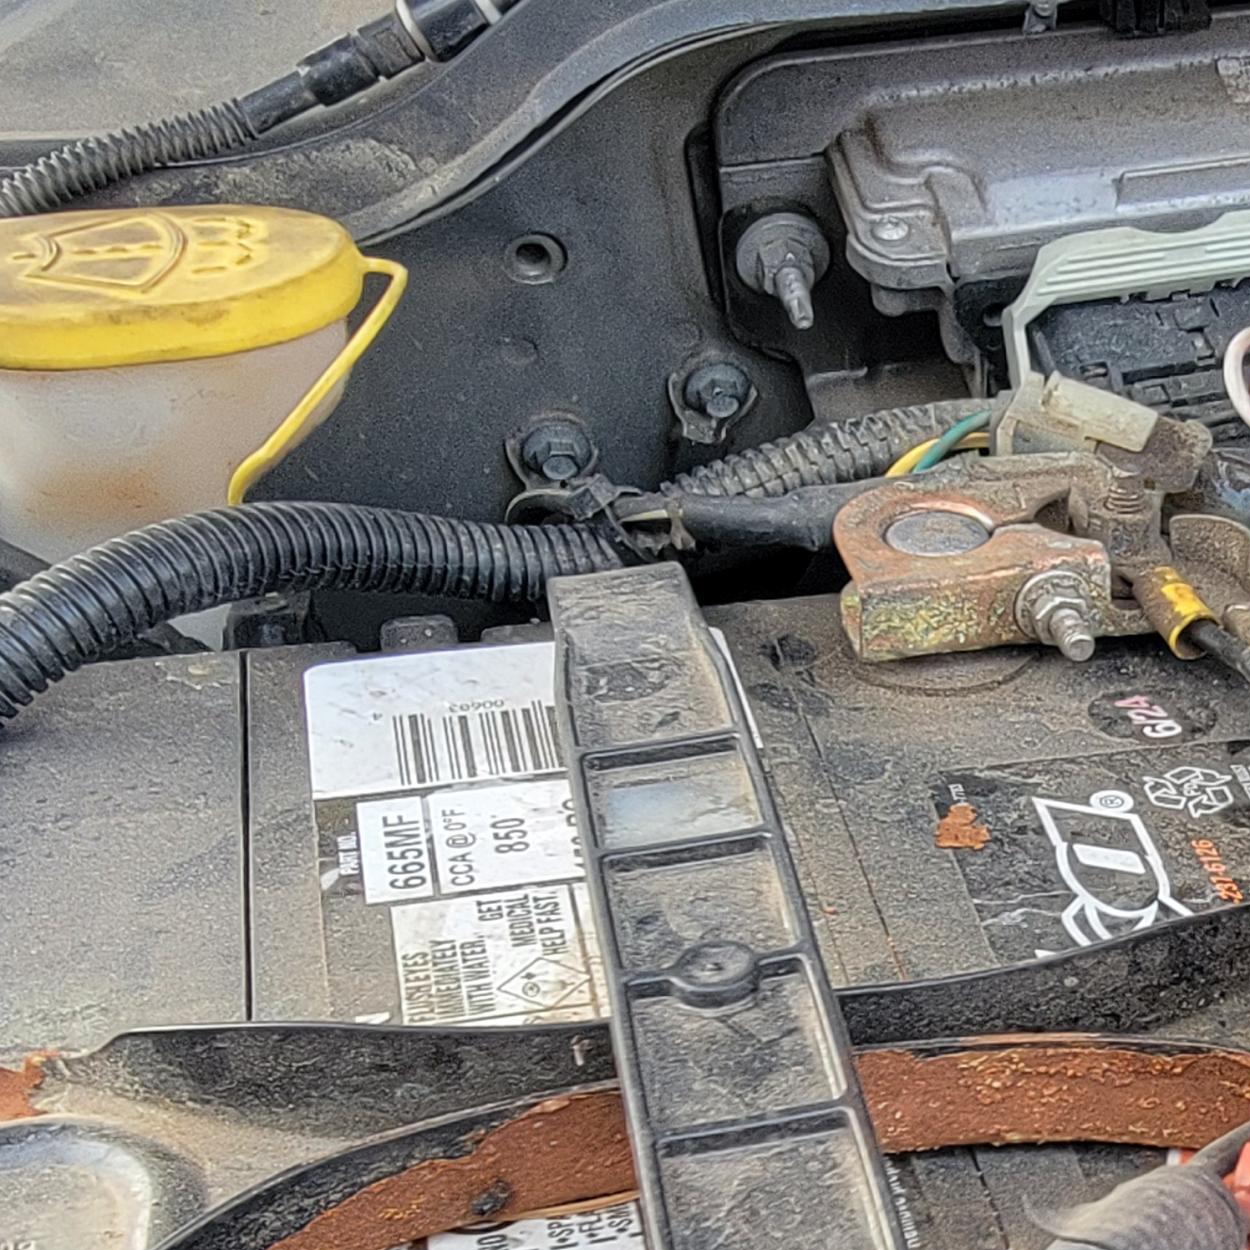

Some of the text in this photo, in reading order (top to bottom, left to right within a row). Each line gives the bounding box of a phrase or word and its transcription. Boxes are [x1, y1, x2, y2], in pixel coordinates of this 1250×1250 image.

[383, 814, 427, 890] 665MF
[490, 817, 531, 854] 850
[448, 852, 476, 886] CCA
[476, 900, 504, 922] GET
[504, 893, 538, 948] MEDICAL
[539, 928, 569, 956] HELP
[401, 951, 436, 1023] FLUSH EYES
[429, 939, 467, 1020] IMMEDIATELY
[466, 982, 497, 1016] WITH
